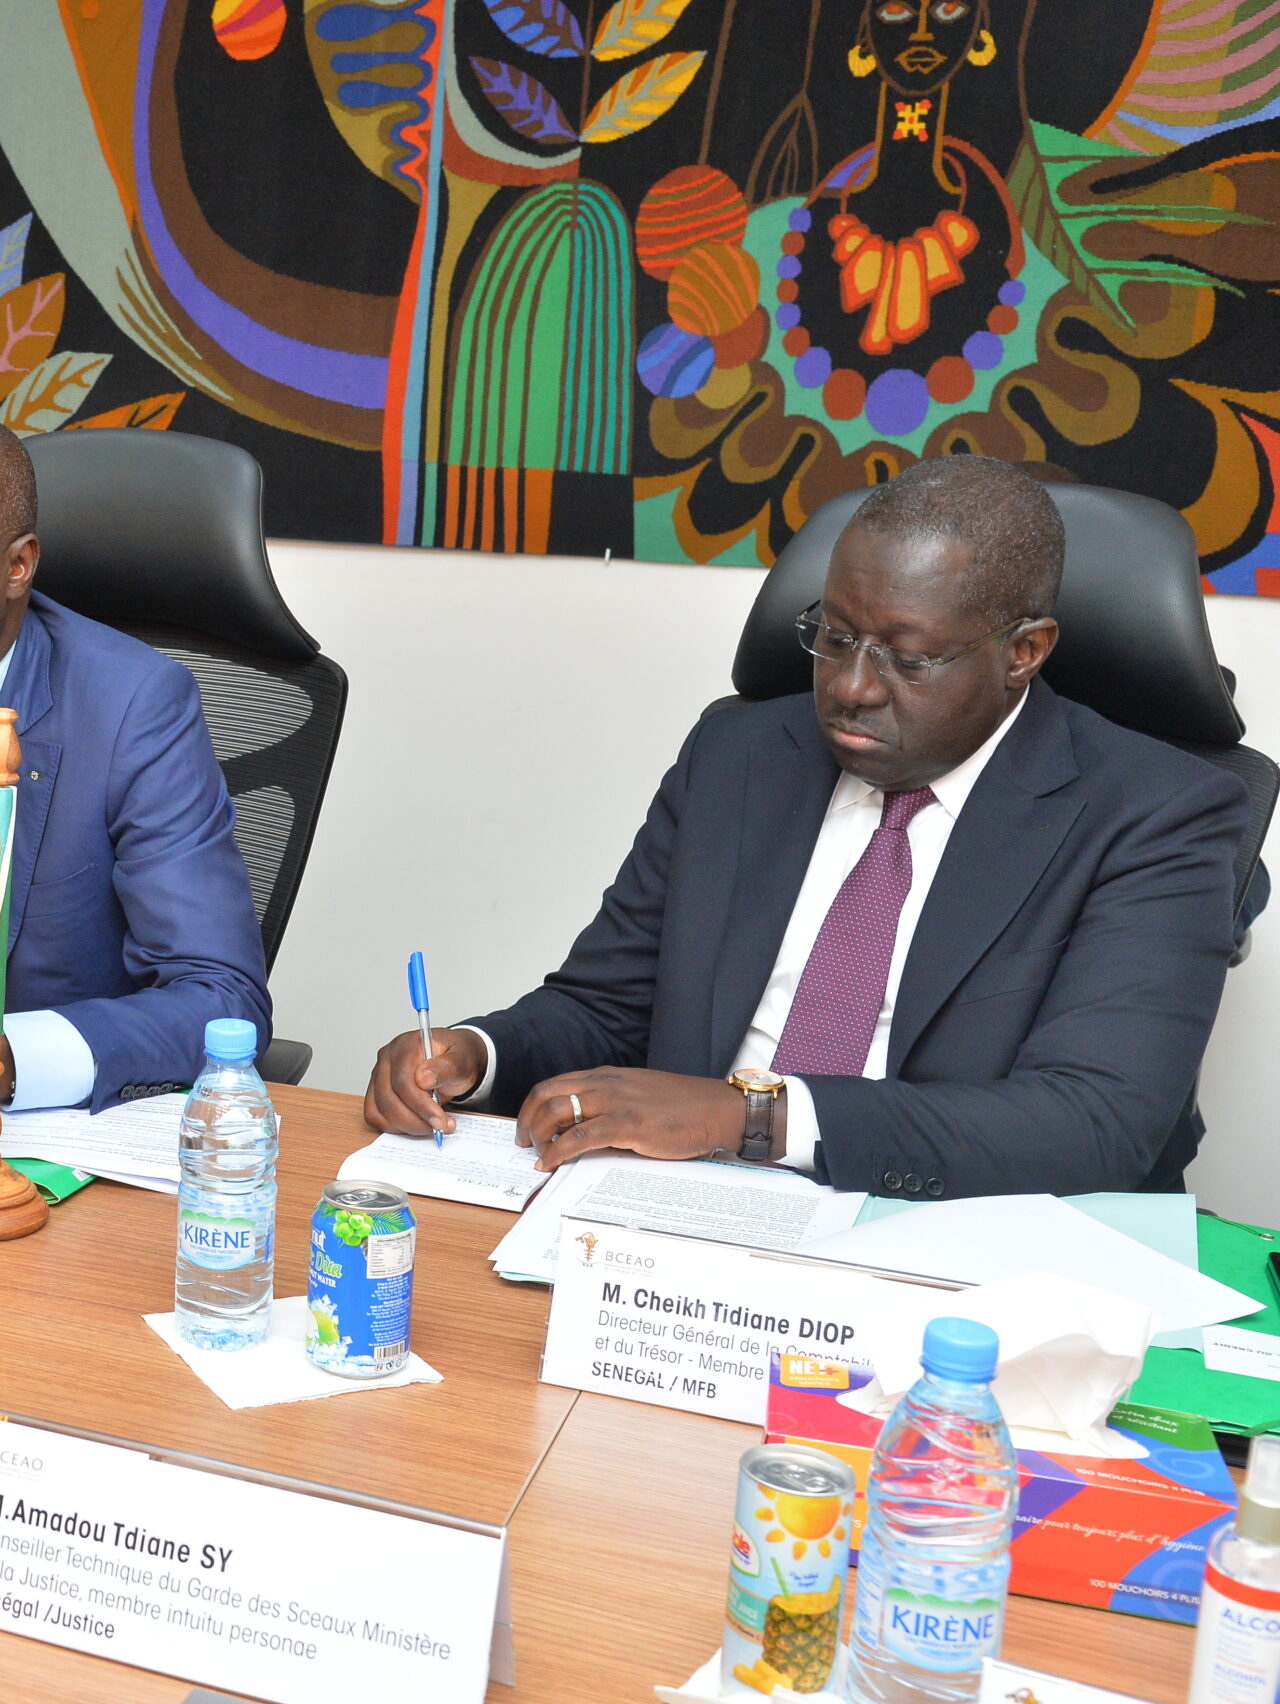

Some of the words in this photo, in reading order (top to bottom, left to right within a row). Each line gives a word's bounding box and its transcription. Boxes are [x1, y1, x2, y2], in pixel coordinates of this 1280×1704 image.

[184, 1222, 251, 1248] KIRÈNE
[605, 1250, 655, 1269] BCEAO
[319, 1273, 337, 1288] WATER
[598, 1309, 669, 1338] Directeur
[672, 1324, 735, 1350] Général
[740, 1336, 761, 1354] de
[602, 1282, 627, 1306] M.
[633, 1287, 707, 1320] Cheikh
[712, 1301, 790, 1335] Tidiane
[798, 1317, 855, 1346] DIOP
[595, 1335, 609, 1350] et
[614, 1337, 634, 1355] du
[638, 1341, 684, 1365] Trésor
[698, 1355, 764, 1382] Membre
[591, 1360, 664, 1390] SENEGAL
[669, 1375, 677, 1392] /
[682, 1378, 717, 1399] MFB
[1075, 1467, 1095, 1476] 100
[1097, 1470, 1169, 1490] MOUCHOIRS
[1181, 1487, 1206, 1497] PLIS
[112, 1522, 191, 1564] Tdiane
[200, 1544, 233, 1573] SY
[1042, 1519, 1071, 1530] pour
[1072, 1522, 1119, 1537] toujours
[1119, 1530, 1144, 1543] plus
[0, 1561, 14, 1582] la
[19, 1567, 83, 1602] Justice,
[88, 1587, 162, 1621] membre
[167, 1602, 223, 1636] intuitu
[66, 1546, 153, 1587] Technique
[159, 1571, 181, 1594] du
[187, 1576, 242, 1609] Garde
[248, 1593, 281, 1619] des
[287, 1601, 356, 1638] Sceaux
[362, 1619, 451, 1661] Ministère
[1089, 1578, 1107, 1588] 100
[1108, 1583, 1170, 1600] MOUCHOIRS
[892, 1604, 995, 1643] KIRÈNE
